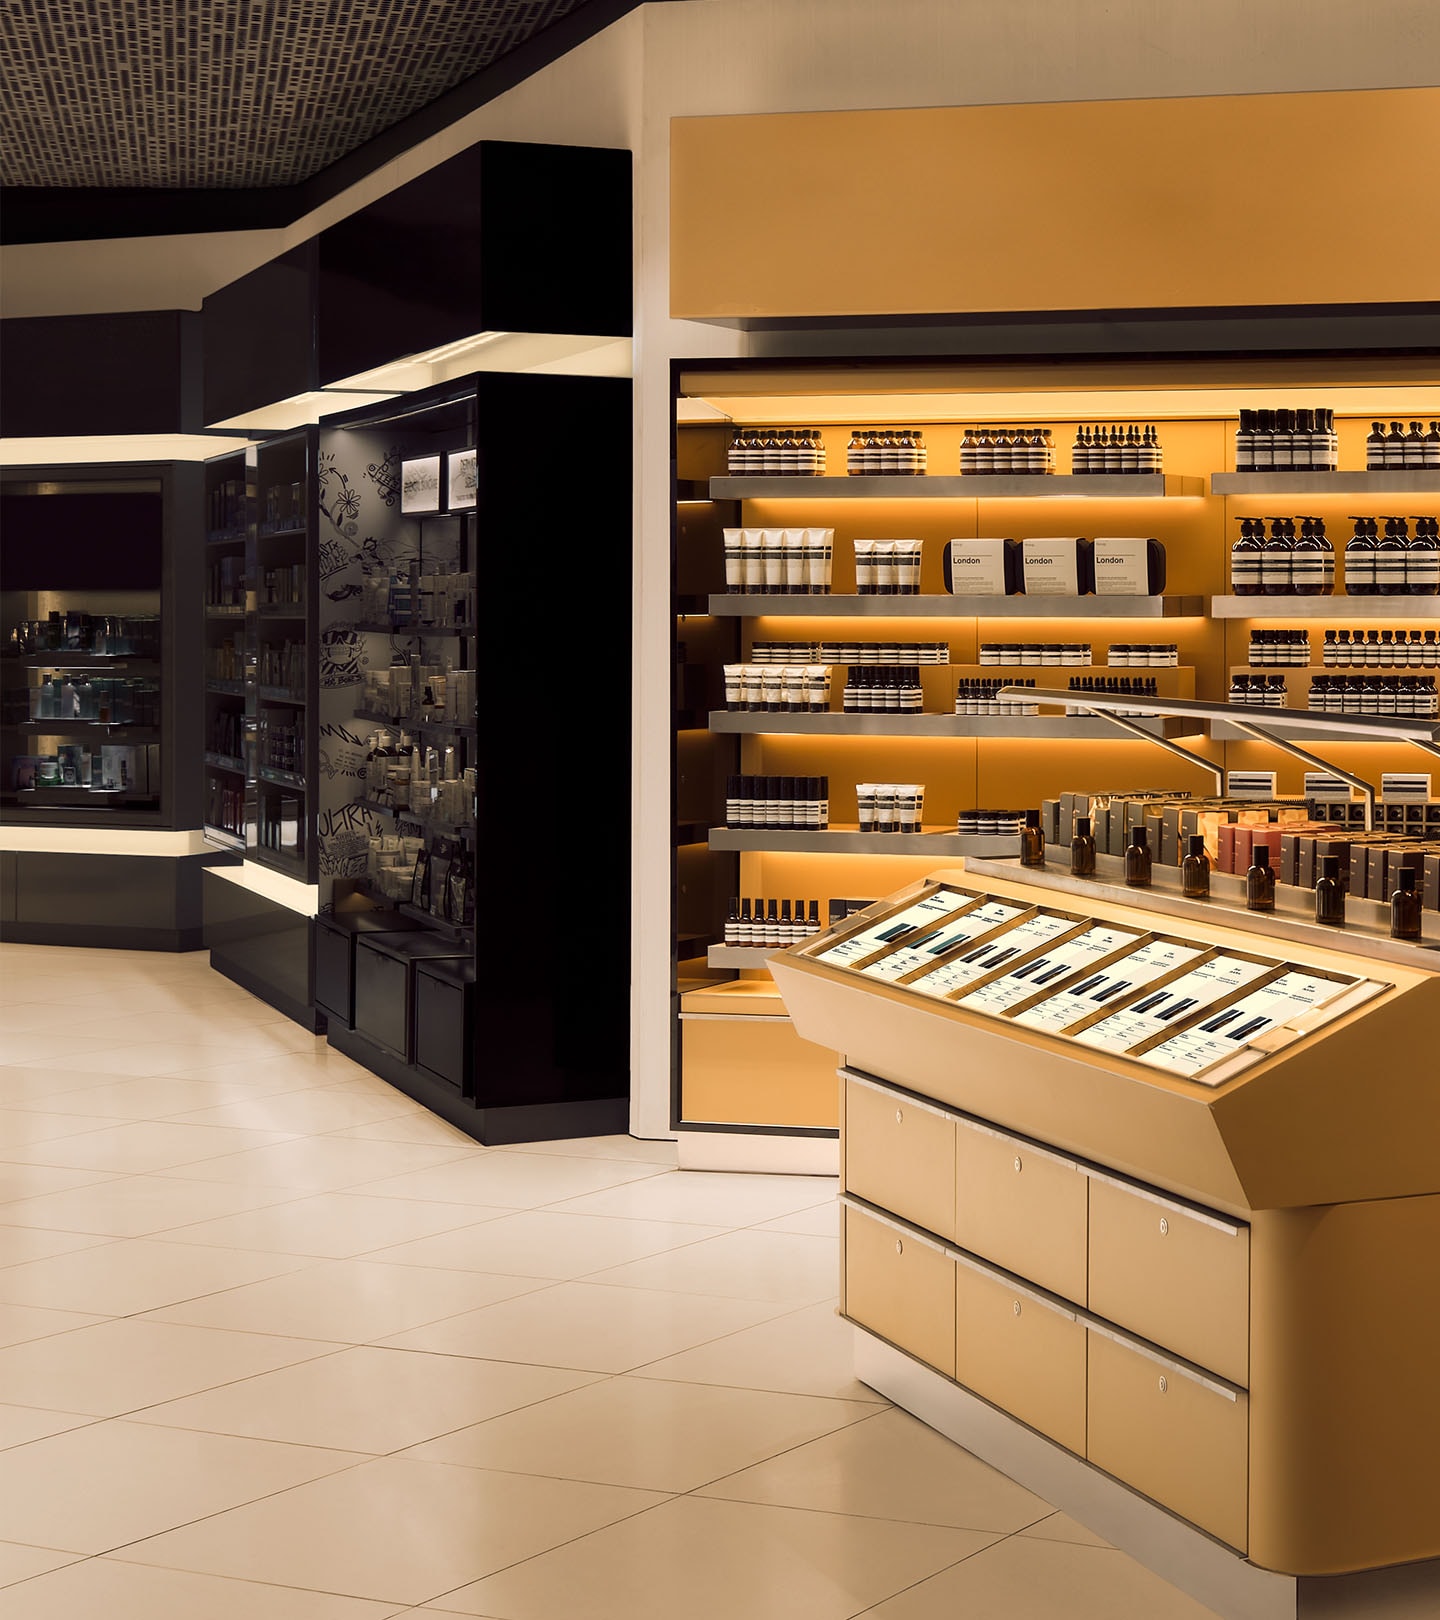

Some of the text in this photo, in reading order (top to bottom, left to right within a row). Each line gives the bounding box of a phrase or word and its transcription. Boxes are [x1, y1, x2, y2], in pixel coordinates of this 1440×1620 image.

[953, 556, 981, 565] London
[1025, 557, 1053, 565] London
[1096, 556, 1124, 564] London
[318, 803, 373, 837] ULTRA
